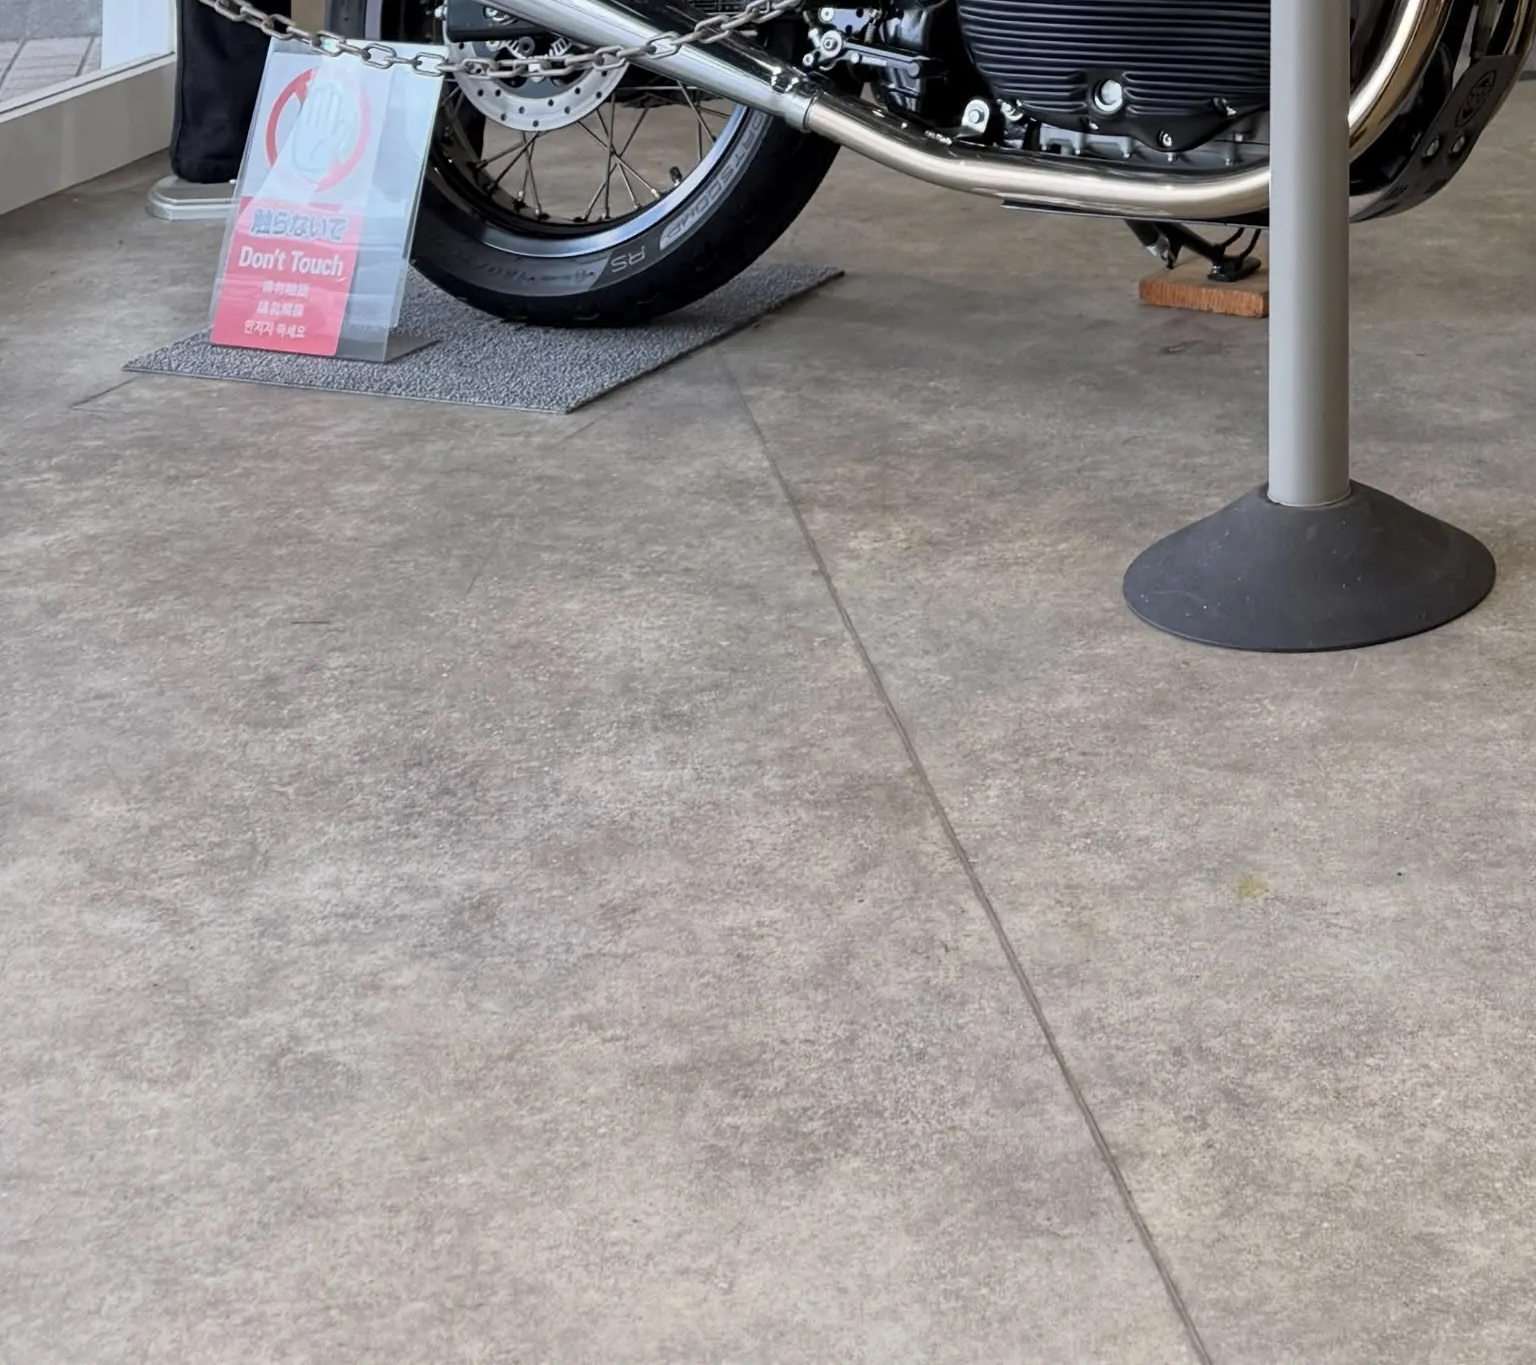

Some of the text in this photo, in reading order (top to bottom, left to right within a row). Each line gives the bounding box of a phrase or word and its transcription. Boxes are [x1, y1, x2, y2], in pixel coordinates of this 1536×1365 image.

[250, 208, 349, 242] 触らないで
[239, 245, 343, 276] Don't Touch
[610, 246, 646, 273] RS
